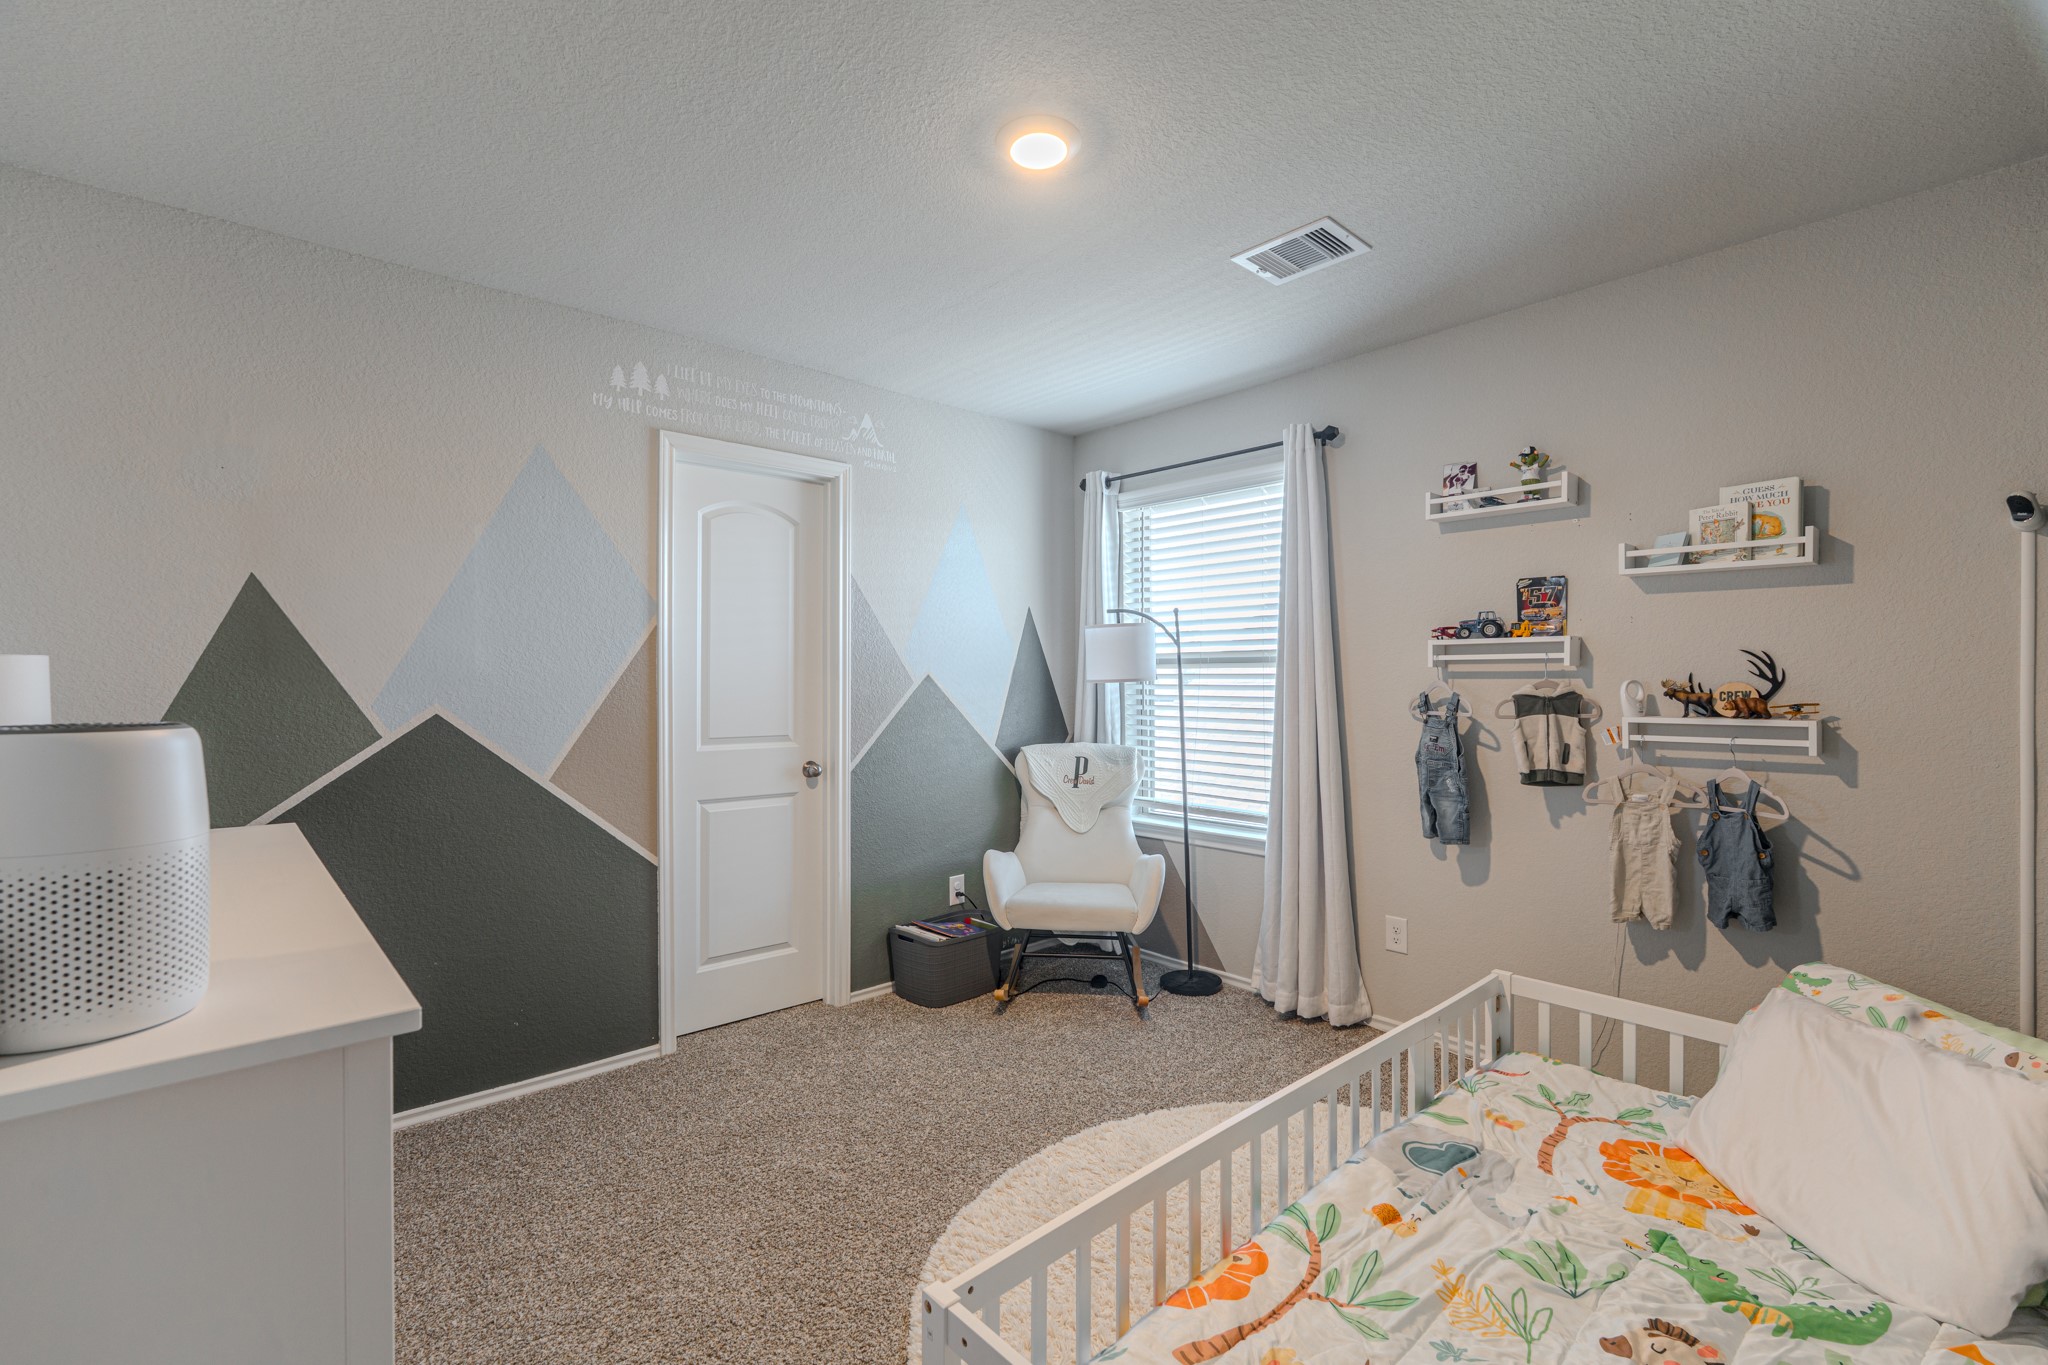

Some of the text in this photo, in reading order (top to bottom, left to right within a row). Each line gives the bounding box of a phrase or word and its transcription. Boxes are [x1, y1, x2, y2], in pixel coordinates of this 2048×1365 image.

[717, 376, 732, 390] MY
[760, 388, 770, 399] TO
[772, 391, 787, 403] THE
[715, 396, 738, 409] DOES
[740, 401, 753, 412] MY
[593, 392, 613, 409] MY
[646, 404, 678, 421] COMES
[765, 427, 779, 440] THE
[857, 447, 872, 458] AND
[1730, 490, 1788, 504] HOW MUCH
[1742, 484, 1775, 495] GUESS
[1767, 498, 1791, 507] YOU
[1698, 510, 1738, 522] Peter Rabbit
[1072, 756, 1088, 788] P
